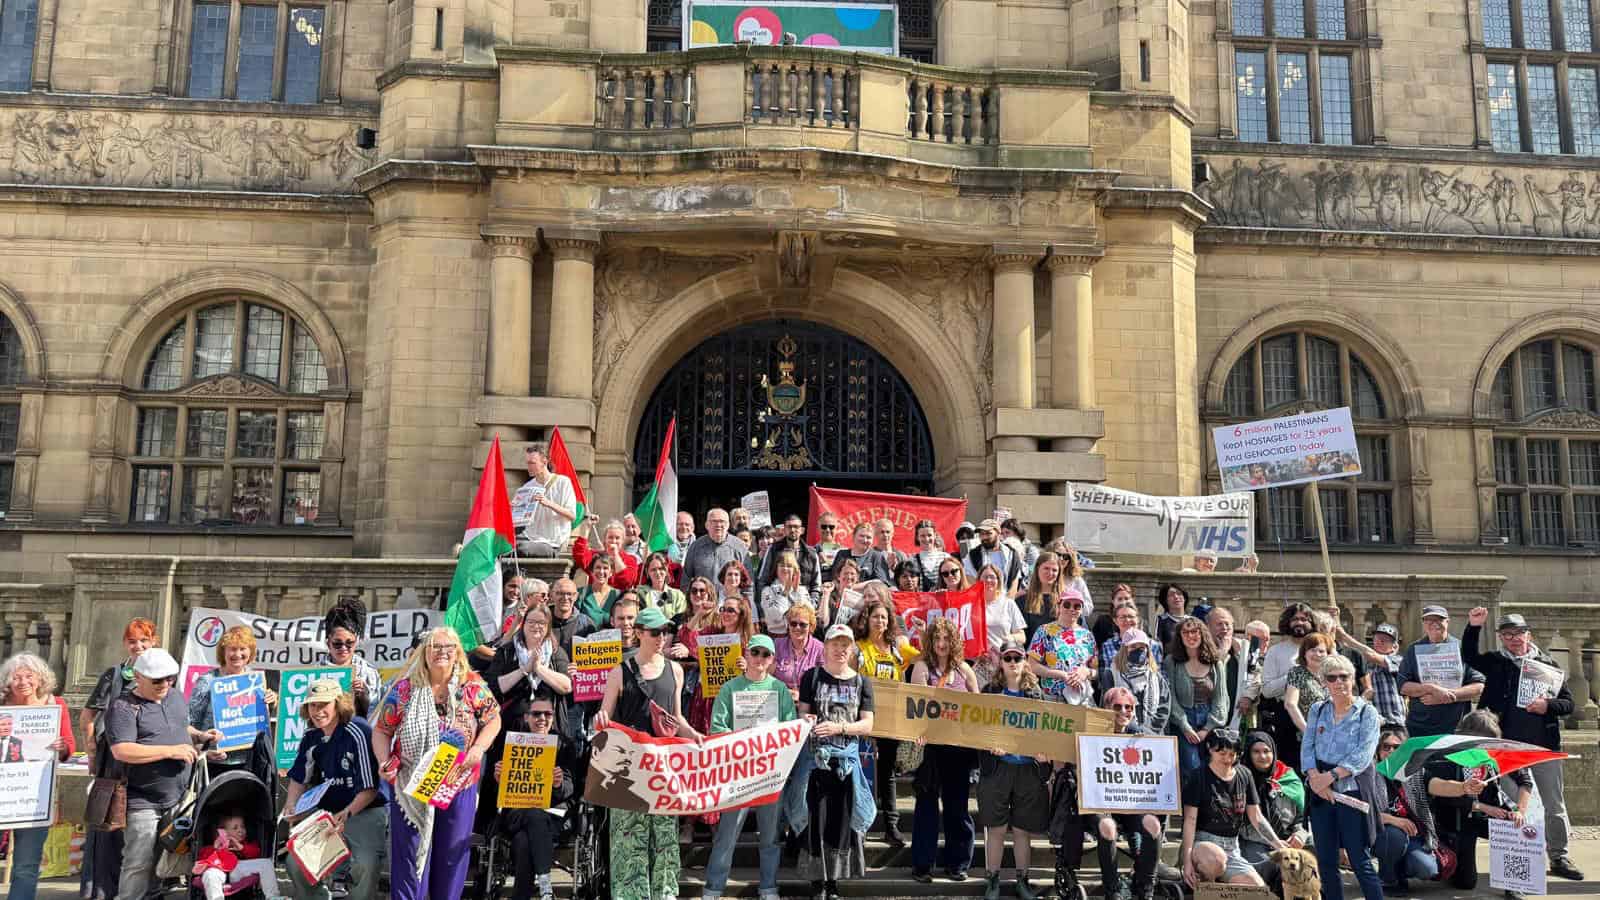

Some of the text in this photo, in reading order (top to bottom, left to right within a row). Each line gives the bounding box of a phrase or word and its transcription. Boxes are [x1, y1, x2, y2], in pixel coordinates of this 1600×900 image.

[1234, 415, 1329, 437] 6 million PALESTINIANS
[1223, 442, 1243, 451] Kept
[1245, 433, 1288, 447] HOSTAGES
[1318, 426, 1343, 437] years
[1225, 442, 1326, 462] And GENOCIDED today
[1073, 490, 1249, 511] SHEFFIELD SAVE OUR
[836, 507, 917, 540] SHEFFIE
[1180, 526, 1248, 551] NHS
[253, 612, 429, 642] SHEFELD
[575, 645, 620, 656] Refugees
[704, 646, 730, 657] STOP
[576, 657, 618, 666] welcome
[705, 657, 725, 666] THE
[576, 671, 599, 682] Stop
[706, 667, 725, 676] FAR
[214, 680, 238, 694] Cut
[576, 683, 591, 694] far
[222, 706, 243, 720] Not
[906, 696, 1075, 734] NO TO THE FOUR POINT RULE
[219, 715, 266, 729] Healthcare
[511, 746, 544, 758] STOP
[510, 758, 534, 769] THE
[417, 778, 432, 794] NO
[430, 759, 442, 774] TO
[424, 753, 455, 797] RACISM
[508, 770, 531, 782] FAR
[648, 752, 778, 795] COMMUNIST
[1094, 767, 1163, 785] the war
[506, 782, 545, 794] RIGHT
[655, 787, 722, 811] PARTY
